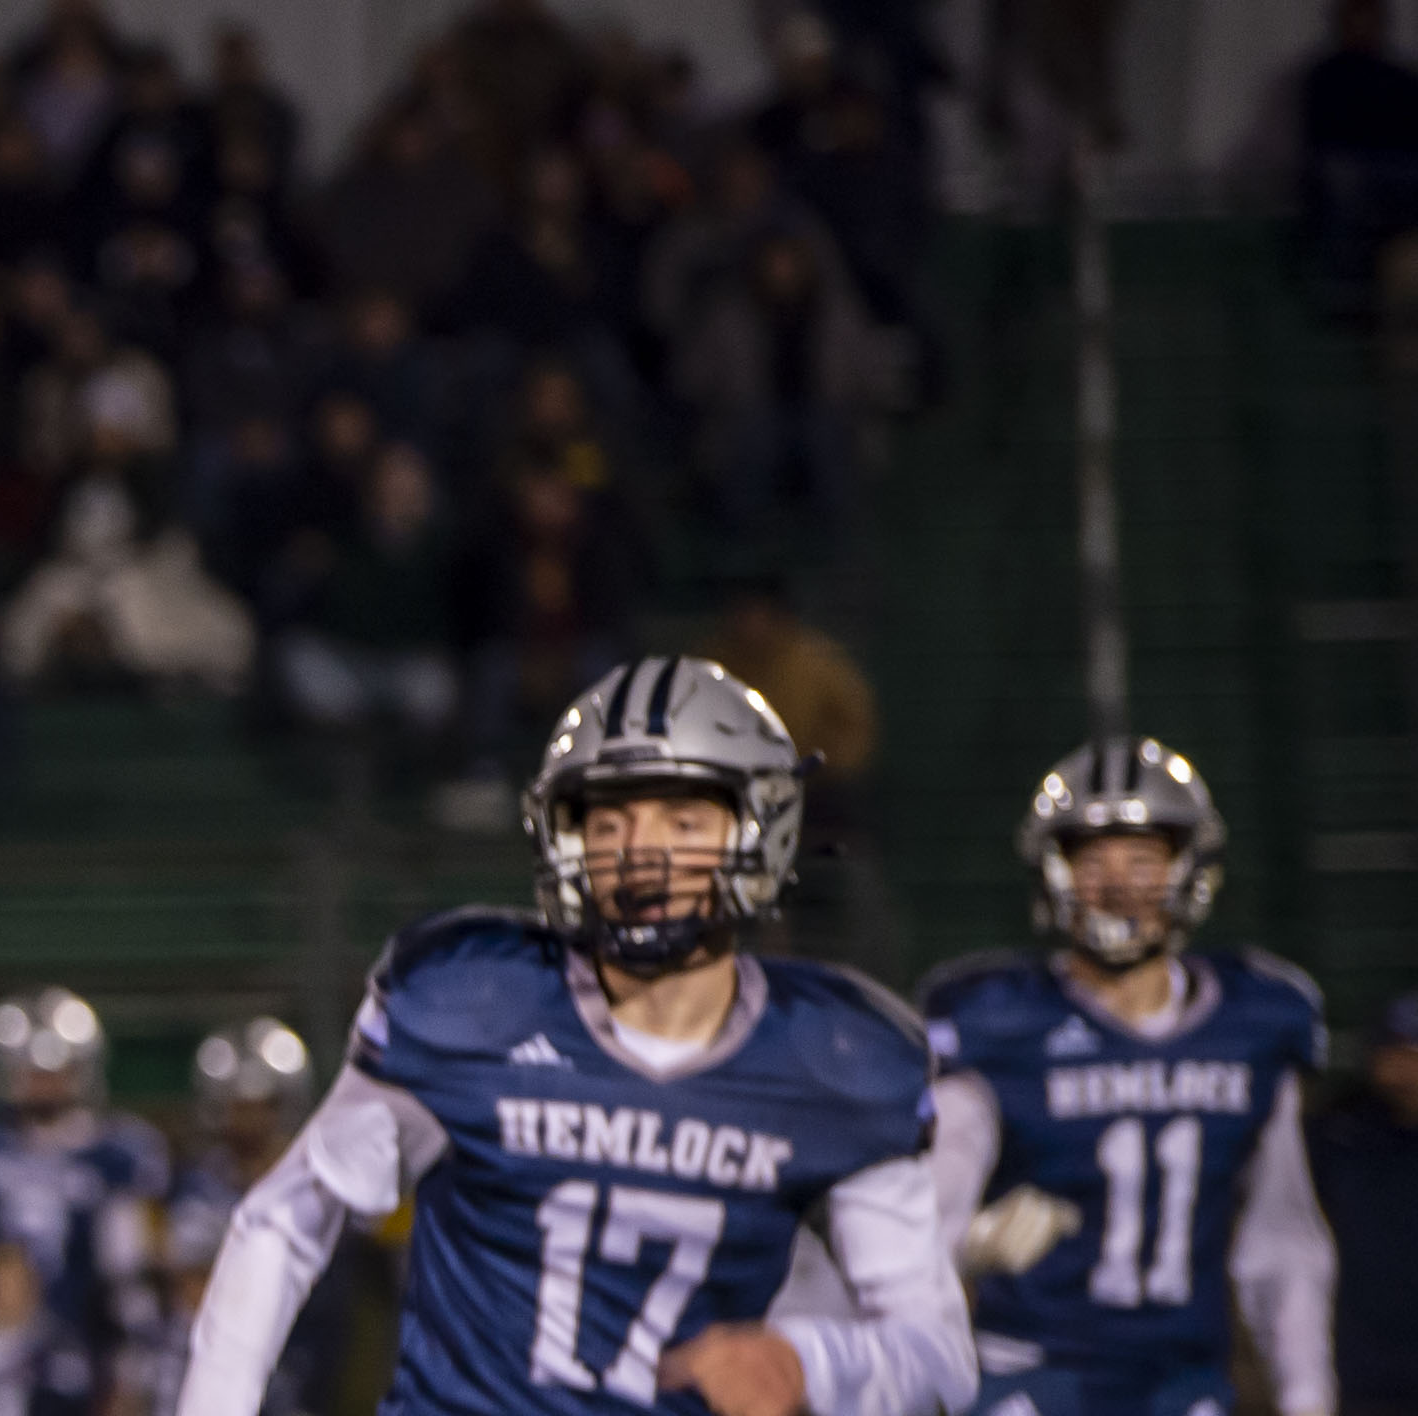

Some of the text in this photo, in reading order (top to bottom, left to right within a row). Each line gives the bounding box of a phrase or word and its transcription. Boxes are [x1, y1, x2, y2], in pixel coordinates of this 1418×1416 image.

[496, 1098, 794, 1193] HEMLOCK
[1089, 1119, 1201, 1306] 11
[531, 1181, 725, 1406] 17
